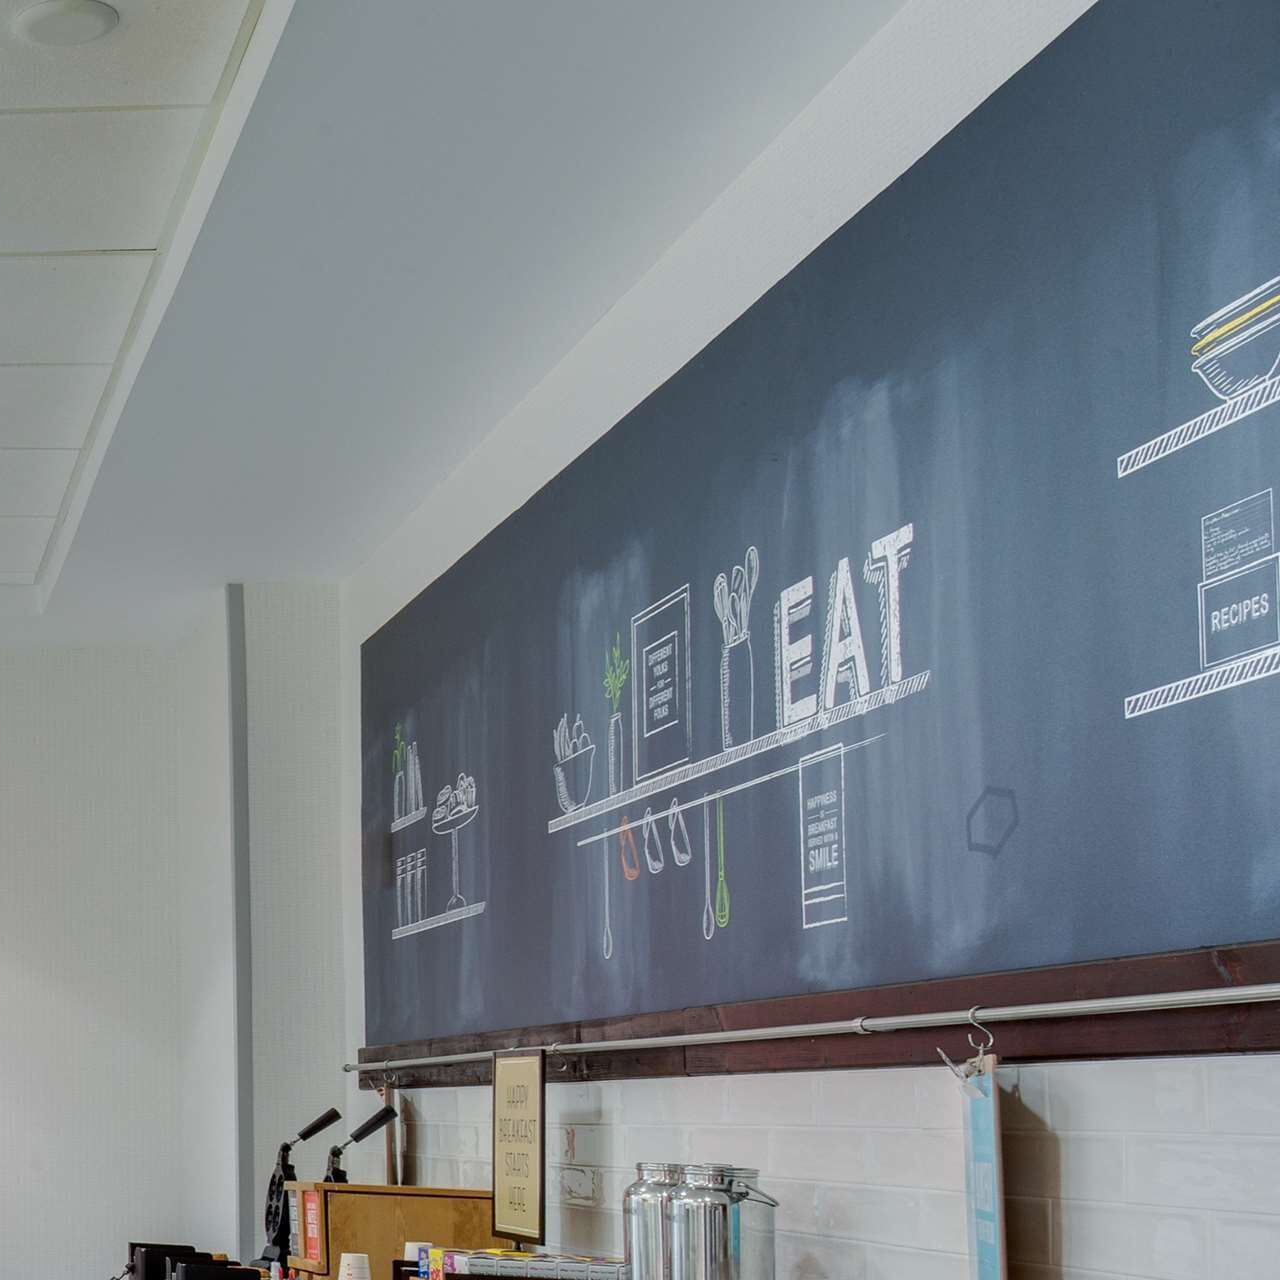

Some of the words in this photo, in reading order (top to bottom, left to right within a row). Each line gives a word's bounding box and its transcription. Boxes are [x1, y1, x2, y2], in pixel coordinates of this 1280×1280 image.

[777, 522, 914, 728] EAT
[1211, 593, 1269, 632] RECIPES
[808, 844, 839, 873] SMILE
